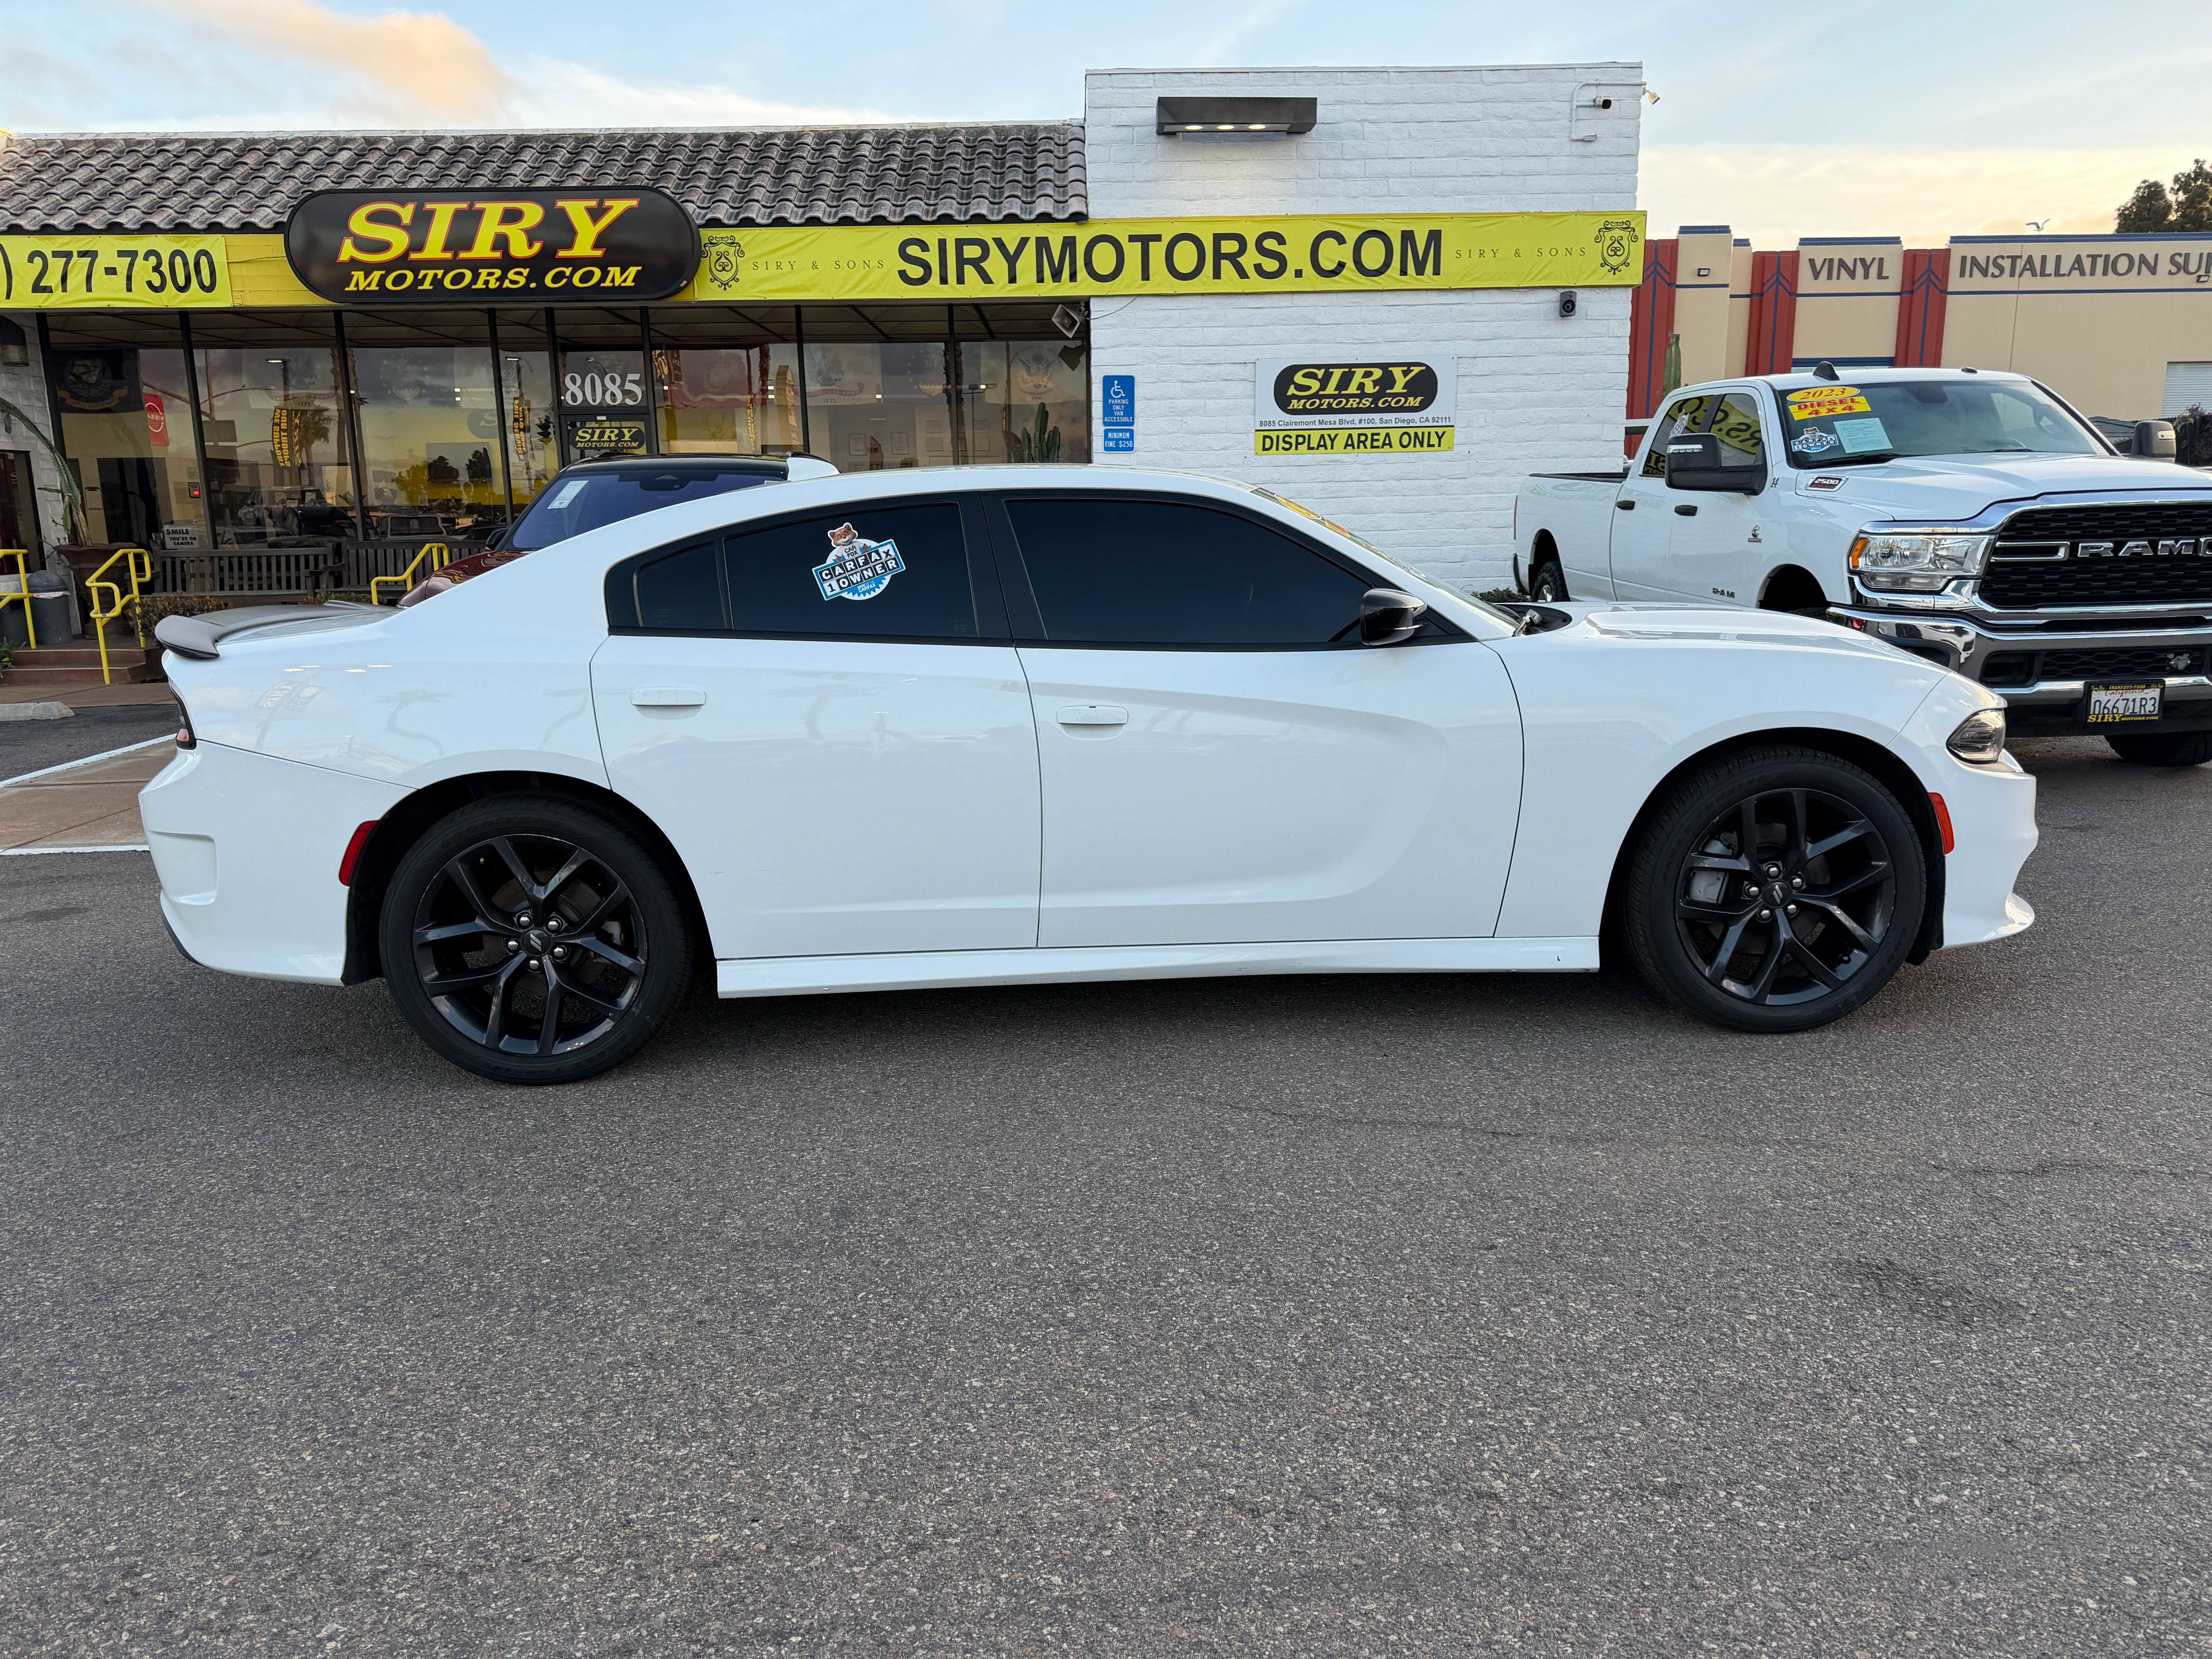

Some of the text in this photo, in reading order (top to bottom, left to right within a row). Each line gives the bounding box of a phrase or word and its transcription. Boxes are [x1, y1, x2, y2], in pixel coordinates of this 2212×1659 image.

[337, 198, 640, 264] SIRY
[898, 229, 1442, 286] SIRYMOTORS.COM
[1455, 247, 1586, 259] SIRY & SONS
[27, 249, 216, 294] 277-7300
[752, 260, 884, 270] SIRY & SONS
[1808, 257, 1889, 280] VINYL
[1960, 252, 2159, 278] INSTALLATION
[345, 266, 642, 291] MOTORS.COM
[1286, 367, 1426, 396] SIRY
[565, 373, 642, 405] 8085
[1800, 388, 1846, 400] 2023
[1287, 397, 1424, 409] MOTORS.COM
[1797, 398, 1860, 410] DIESEL
[575, 428, 639, 441] SIRY
[1795, 436, 1834, 445] CARFAX
[1262, 431, 1446, 452] DISPLAY AREA ONLY
[844, 545, 857, 554] CAR
[2078, 540, 2195, 558] RAM
[822, 549, 891, 580] CARFAX
[859, 582, 876, 593] CARFAX
[1712, 587, 1736, 598] RAM
[2088, 714, 2123, 723] SIRY
